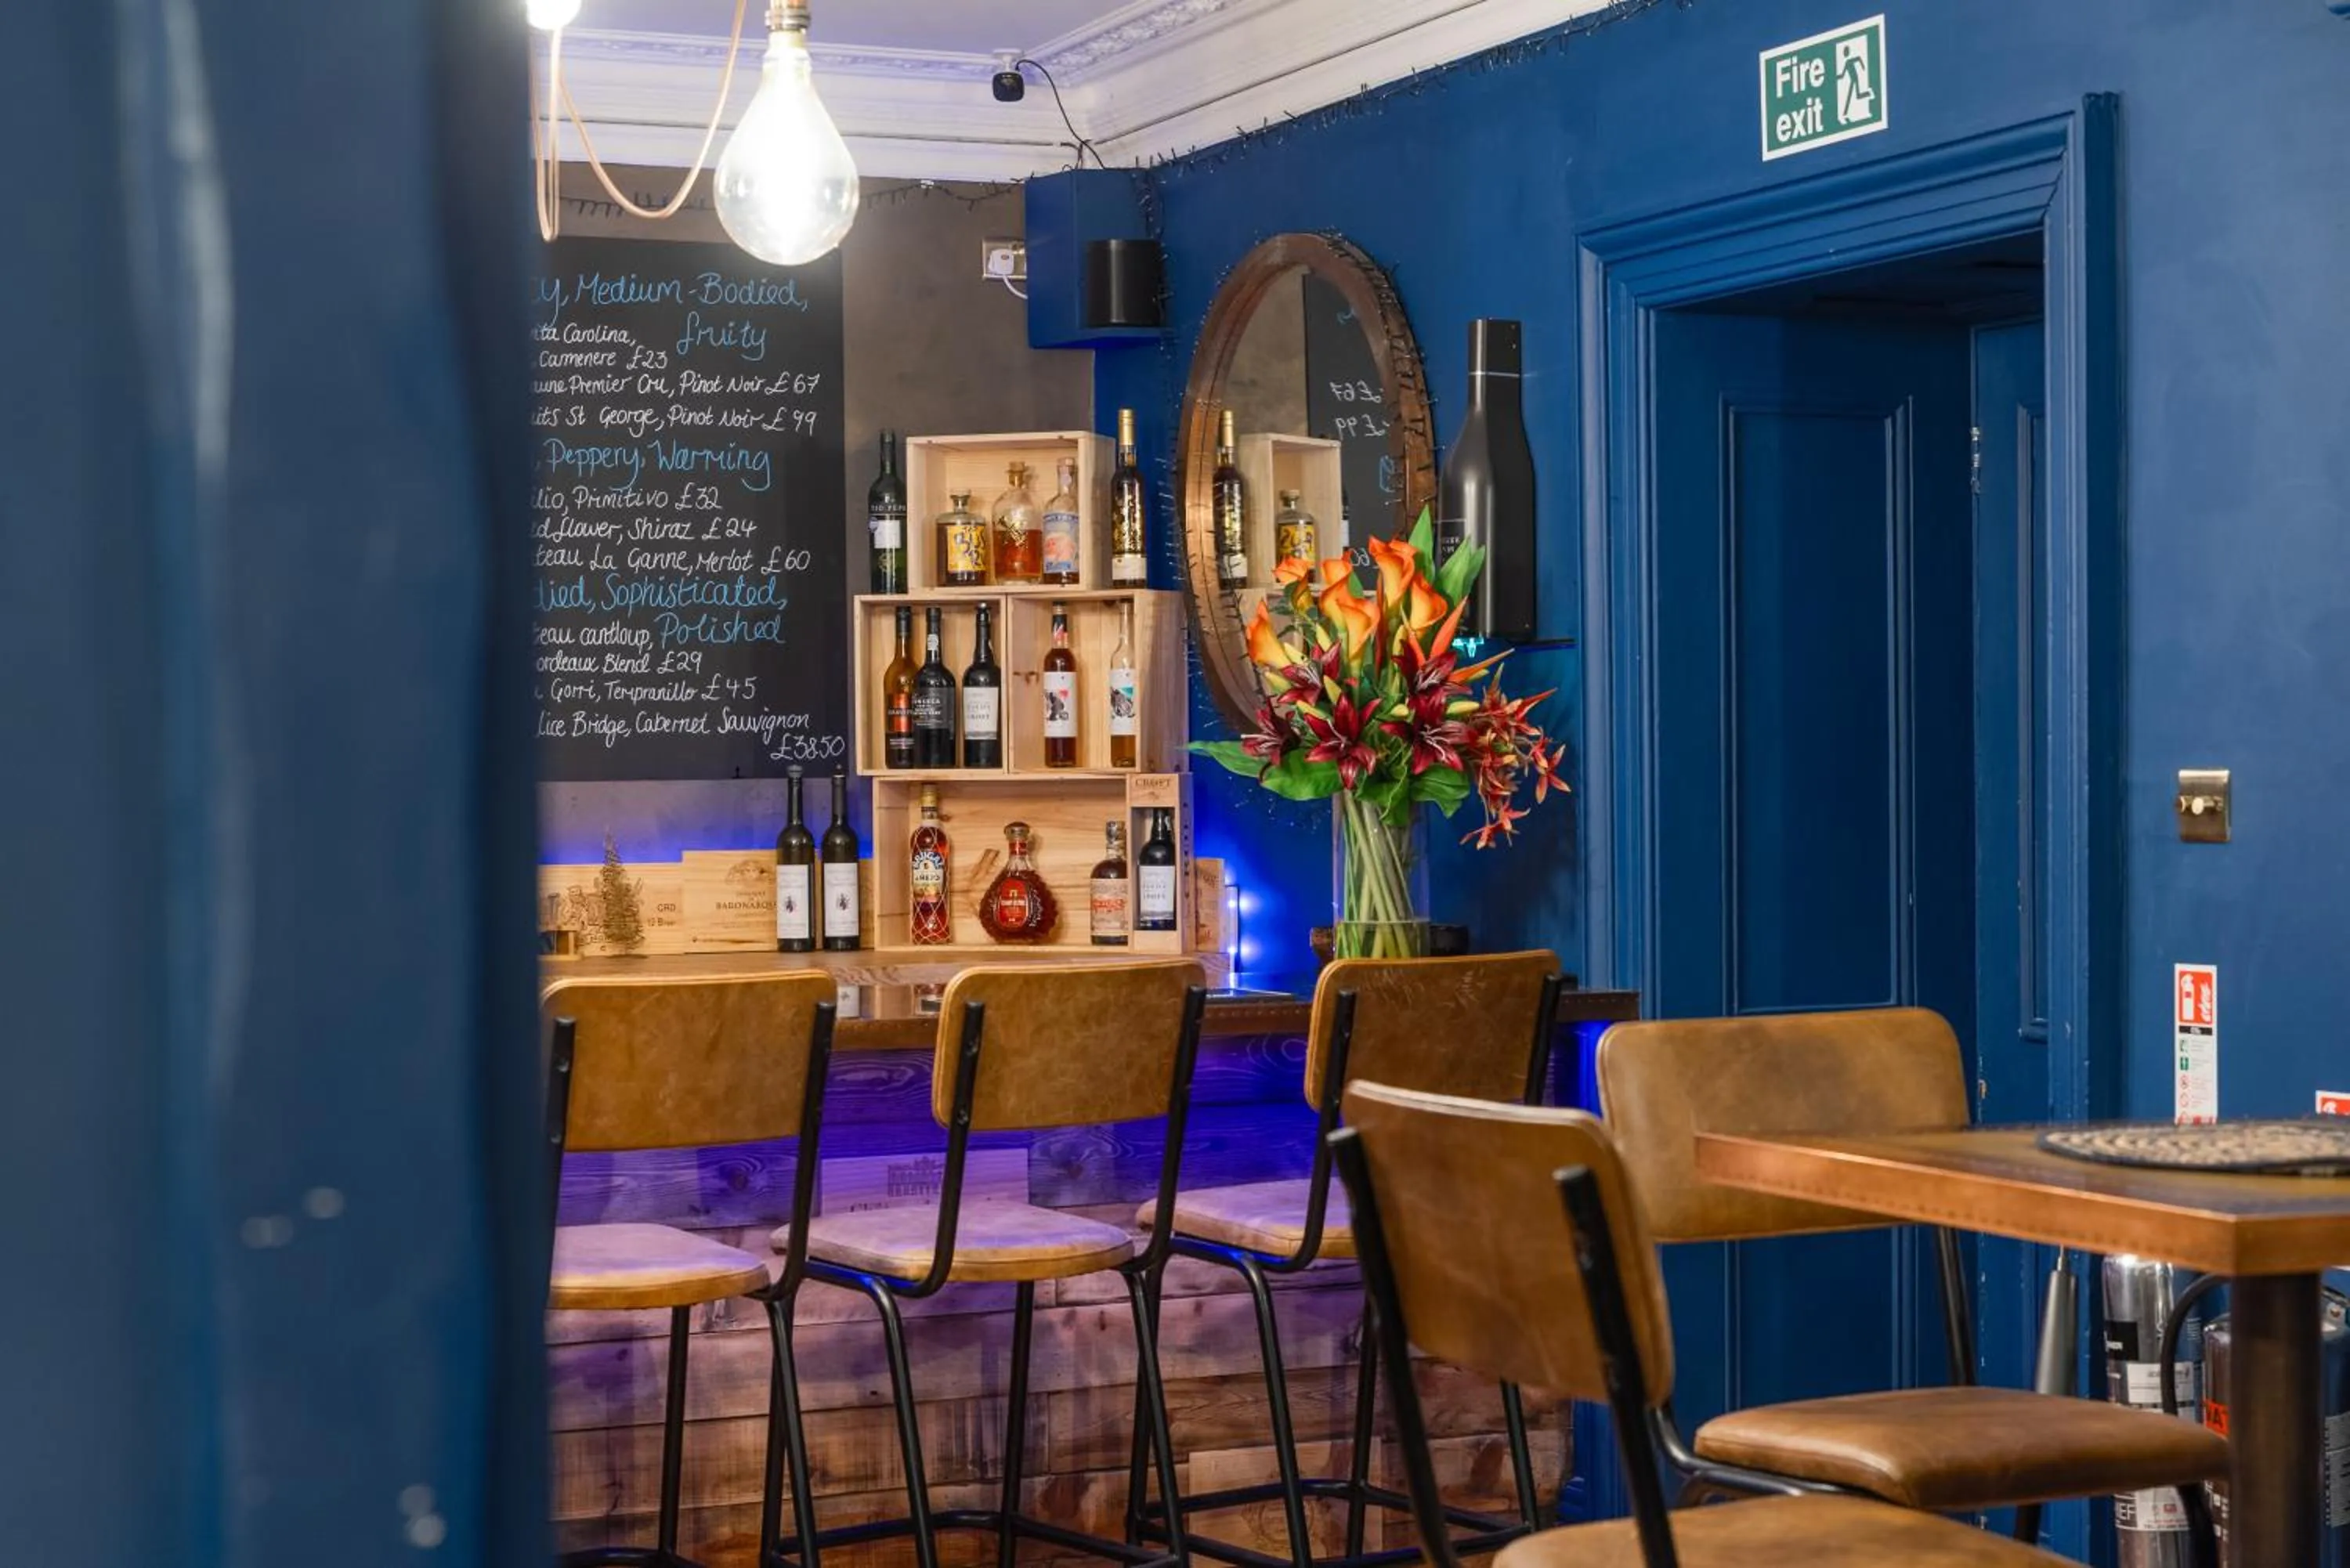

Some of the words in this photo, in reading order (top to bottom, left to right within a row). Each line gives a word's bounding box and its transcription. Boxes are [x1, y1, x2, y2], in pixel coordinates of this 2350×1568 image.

[1776, 56, 1825, 98] Fire
[1776, 97, 1824, 143] exit
[563, 323, 637, 346] Carolina,
[627, 345, 668, 369] £23
[569, 374, 632, 395] Premier
[679, 370, 723, 396] Pinot
[727, 374, 765, 393] Noir
[565, 405, 586, 427] St
[599, 405, 664, 438] George,
[667, 403, 714, 429] Pinot
[718, 407, 765, 427] Noir
[647, 439, 772, 491] Warming
[573, 485, 668, 510] Primitivo
[674, 482, 722, 511] £32
[627, 517, 695, 541] Shiraz
[702, 517, 758, 540] £24
[590, 543, 617, 571] La
[696, 547, 753, 572] Merlot
[761, 544, 811, 574] £60
[602, 573, 788, 617] Sophisticated,
[653, 611, 786, 649] Polished
[602, 652, 651, 674] Blend
[657, 651, 703, 674] £29
[702, 674, 757, 701] £45
[572, 710, 631, 749] Bridge,
[635, 710, 710, 735] Cabernet
[716, 706, 811, 745] Sauvignon
